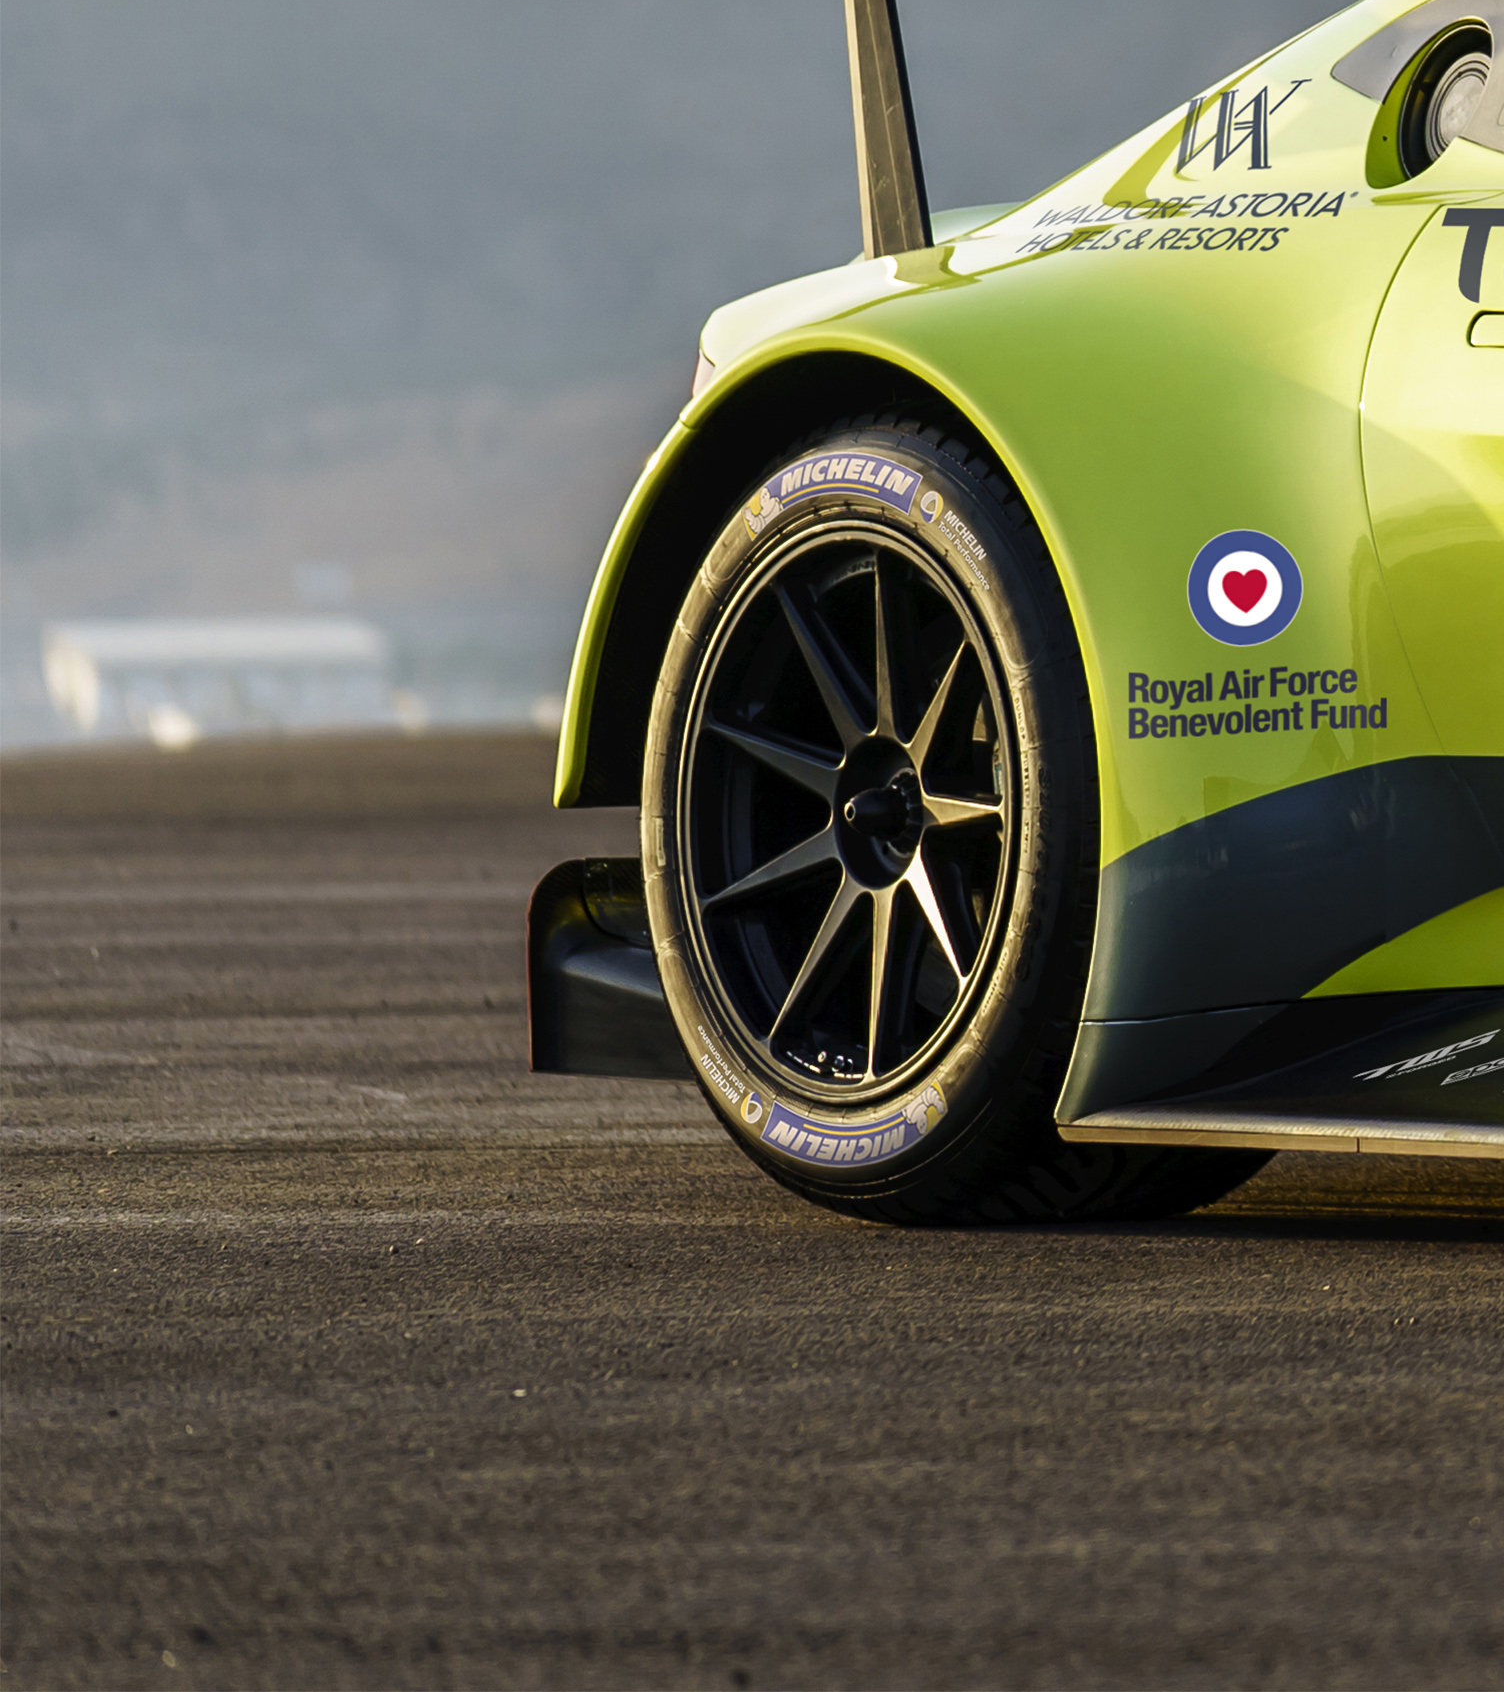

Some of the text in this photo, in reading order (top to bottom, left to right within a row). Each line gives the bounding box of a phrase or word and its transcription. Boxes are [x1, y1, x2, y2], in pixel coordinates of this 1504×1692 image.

[1032, 191, 1347, 229] WALDORF ASTORIA
[1015, 227, 1290, 254] HOTELS & RESORTS
[780, 458, 915, 496] MICHELIN
[938, 520, 991, 591] Total Performance
[944, 510, 988, 561] MICHELIN
[1128, 666, 1358, 710] Royal Air Force
[1128, 698, 1388, 740] Benevolent Fund
[697, 1025, 746, 1095] Total Performance
[700, 1054, 741, 1105] MICHELIN
[768, 1120, 906, 1163] MICHELIN
